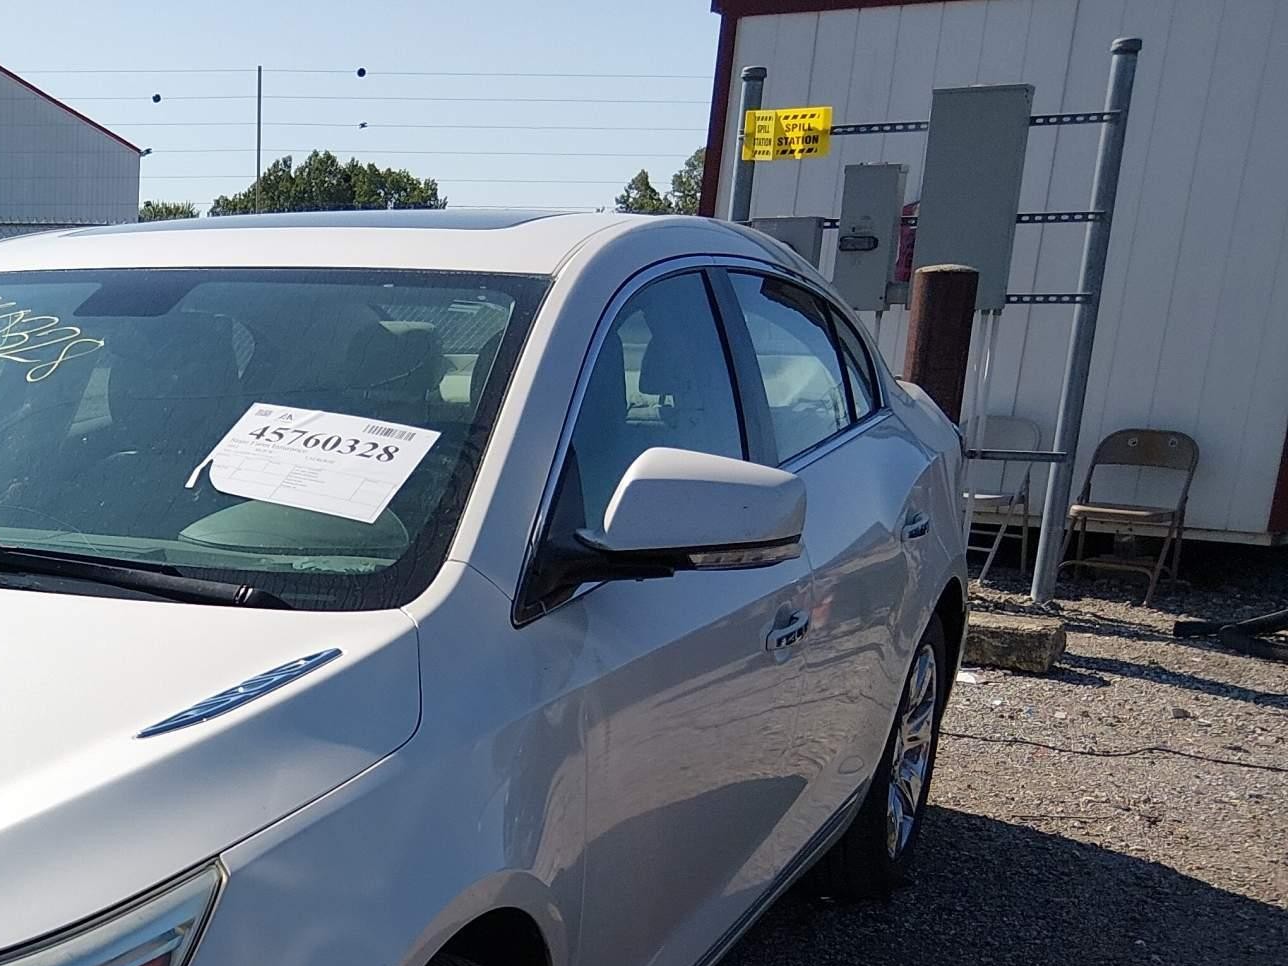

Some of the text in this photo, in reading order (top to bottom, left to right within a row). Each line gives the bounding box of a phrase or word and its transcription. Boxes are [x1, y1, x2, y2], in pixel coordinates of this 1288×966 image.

[784, 122, 815, 133] SPILL
[776, 134, 819, 147] STATION
[248, 425, 400, 463] 45760328
